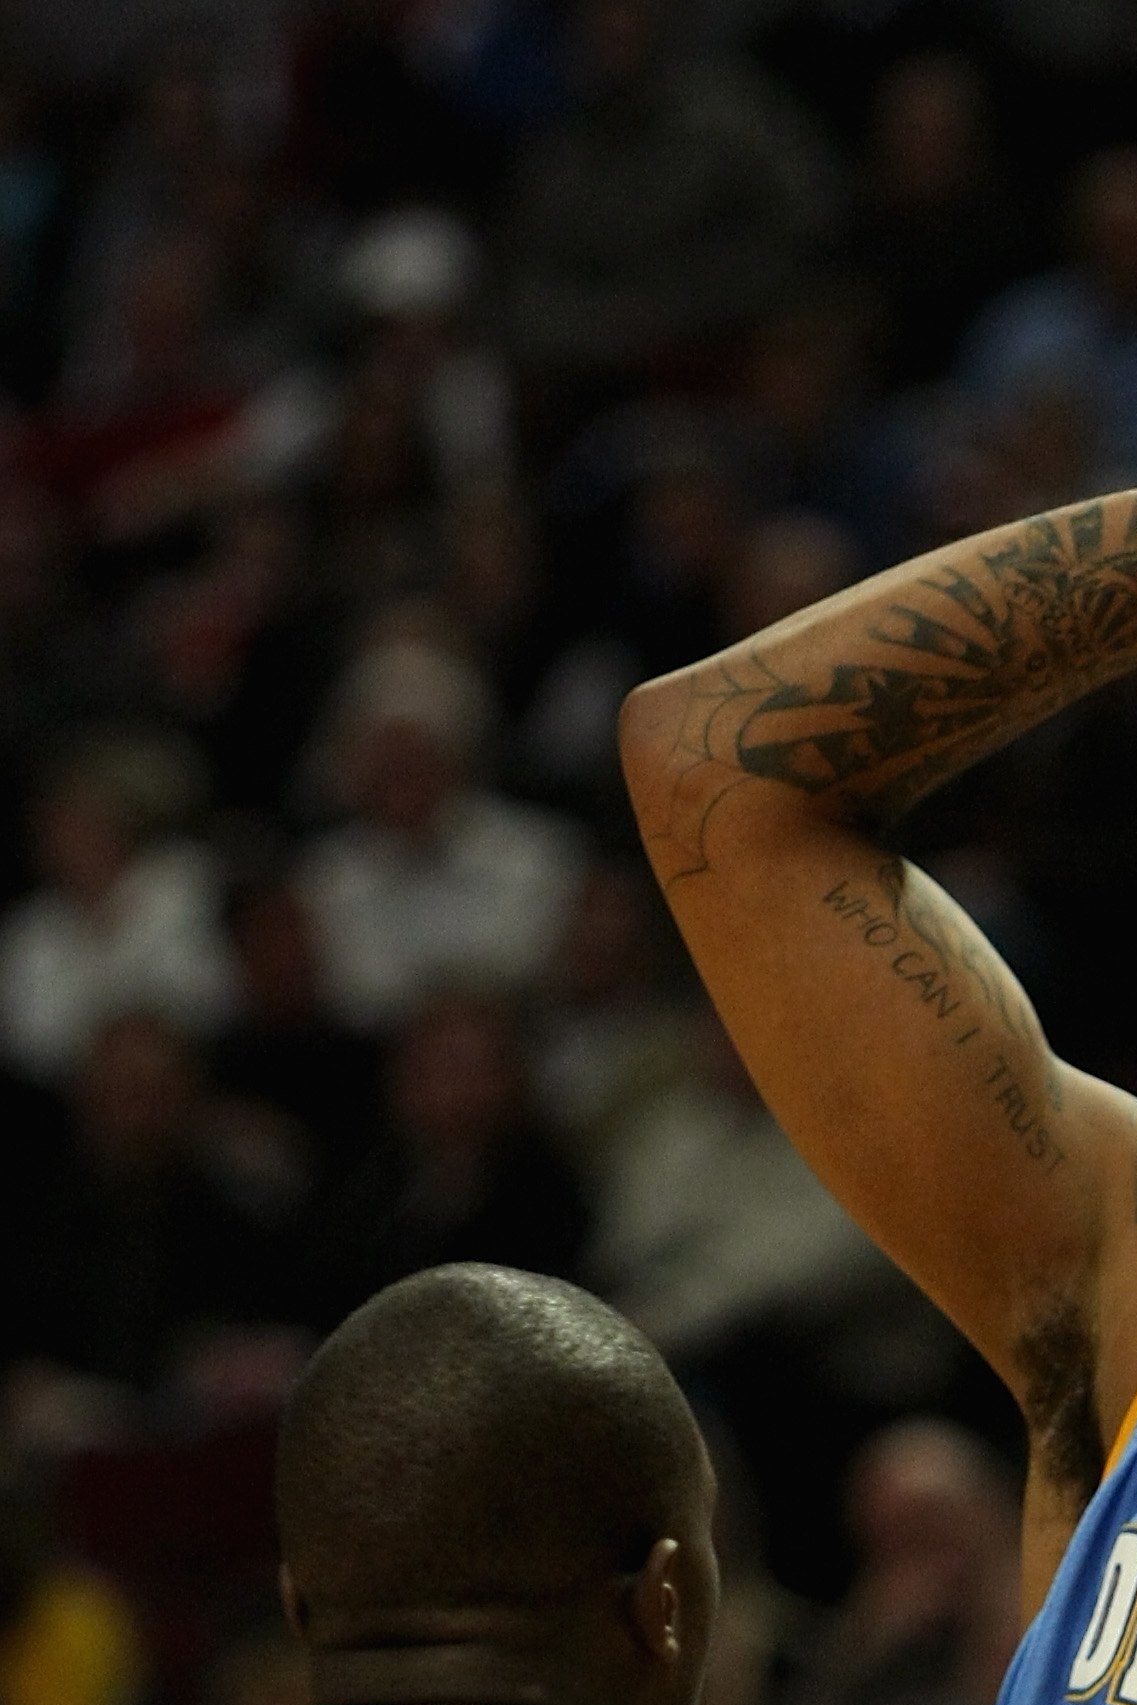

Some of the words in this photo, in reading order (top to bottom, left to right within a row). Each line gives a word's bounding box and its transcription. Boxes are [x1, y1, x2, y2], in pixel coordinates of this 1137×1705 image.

[822, 880, 898, 946] WHO
[891, 951, 962, 1019] CAN
[956, 1027, 981, 1045] I
[985, 1055, 1066, 1173] TRUST
